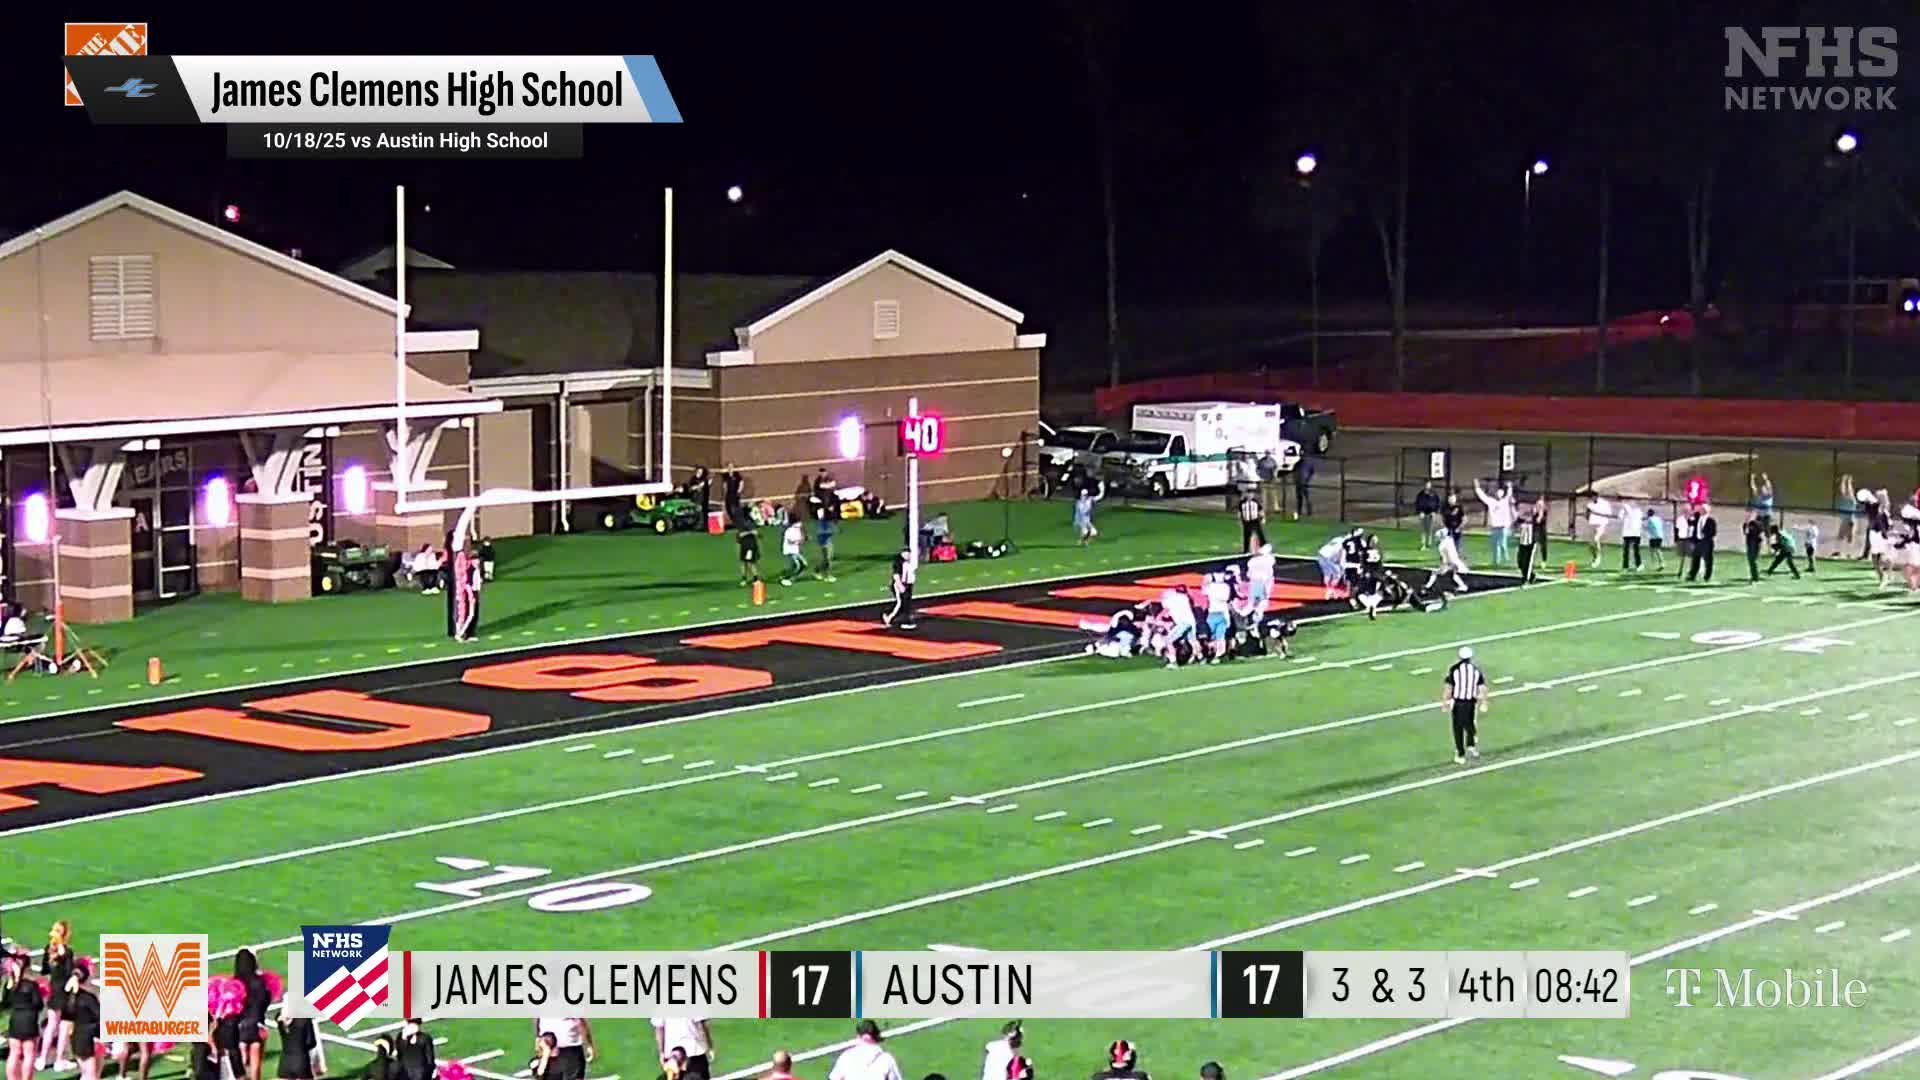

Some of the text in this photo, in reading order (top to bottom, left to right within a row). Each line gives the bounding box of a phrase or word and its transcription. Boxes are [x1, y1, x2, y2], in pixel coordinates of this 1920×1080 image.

[905, 417, 938, 453] 40
[303, 443, 327, 546] USTIN
[414, 865, 653, 911] 10
